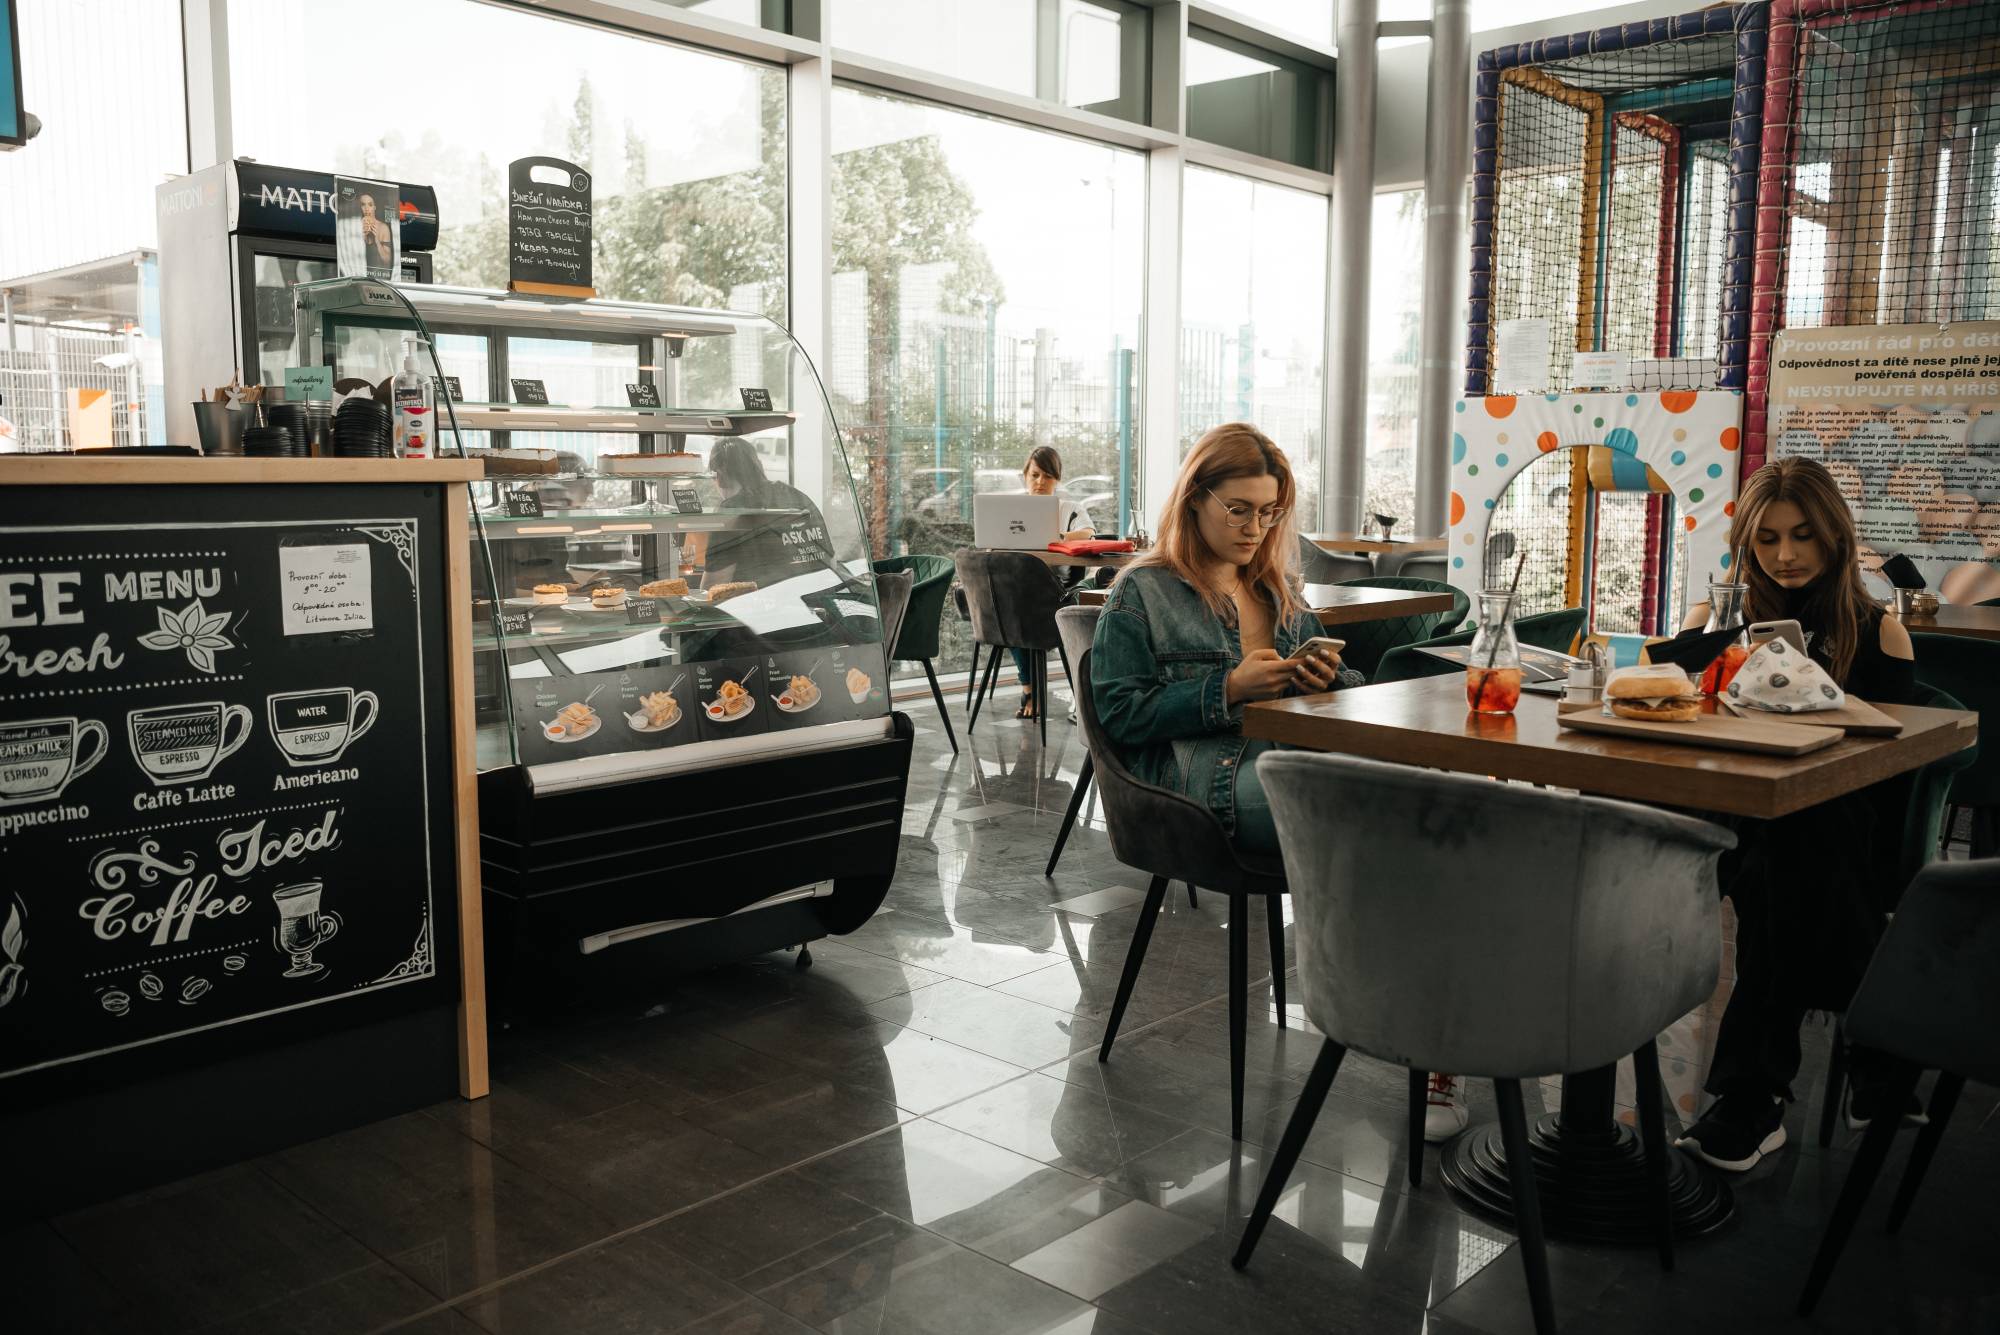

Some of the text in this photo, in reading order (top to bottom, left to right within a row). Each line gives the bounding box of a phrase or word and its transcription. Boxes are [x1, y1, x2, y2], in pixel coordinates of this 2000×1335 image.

[160, 185, 203, 216] MATTONI
[517, 226, 582, 243] BBQ BAGEL
[520, 242, 579, 256] KEBAB BAGEL
[369, 292, 394, 301] JUKA
[1782, 336, 1873, 353] Provozní
[1876, 334, 1912, 350] řád
[1919, 337, 1956, 352] pro
[1778, 358, 1860, 370] Odpovědnost
[1864, 359, 1879, 367] za
[1883, 357, 1909, 366] dítě
[1950, 355, 1981, 367] plně
[1855, 369, 1917, 381] pověřená
[1921, 368, 1975, 380] dospělá
[627, 384, 649, 393] BBQ
[1787, 384, 1916, 398] NEVSTUPUJTE
[1921, 384, 1948, 397] NA
[781, 527, 823, 546] ASK ME
[104, 568, 221, 602] MENU
[297, 705, 328, 717] WATER
[144, 724, 211, 742] STEAMED MILK
[295, 731, 330, 745] ESPRESSO
[159, 752, 200, 765] ESPRESSO
[4, 766, 49, 783] ESPRESSO
[133, 784, 236, 811] Caffe Latte
[219, 810, 339, 876] Iced
[79, 873, 252, 946] Coffee
